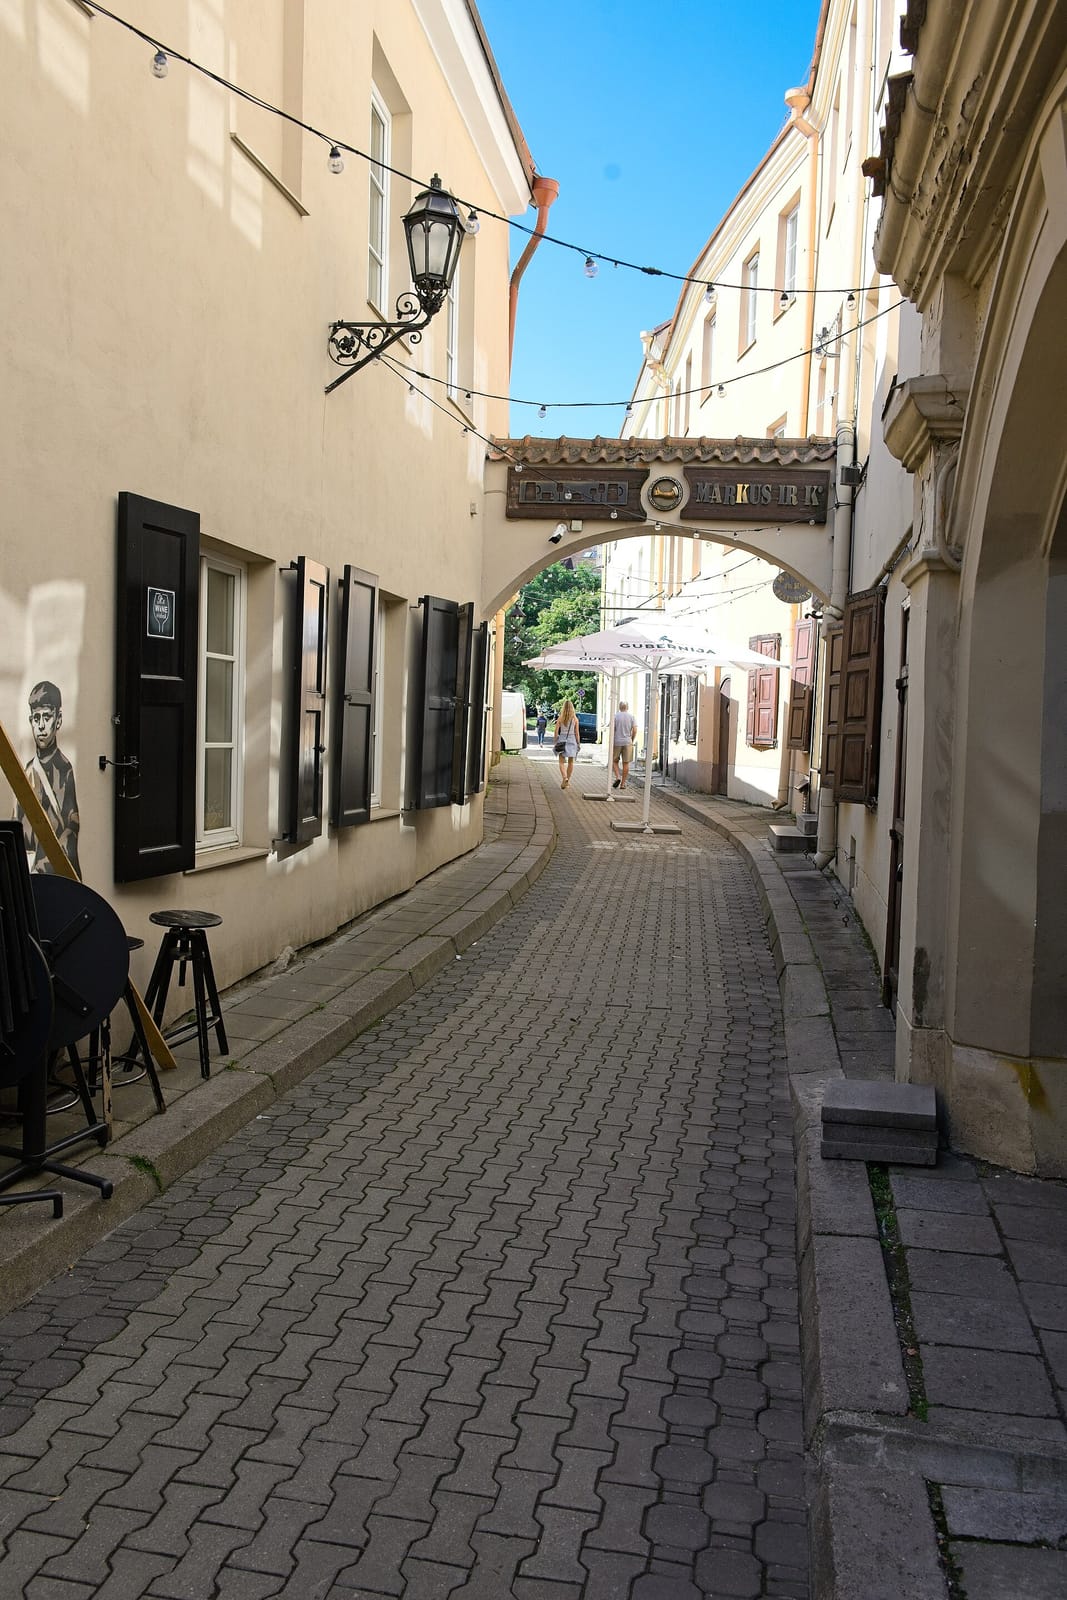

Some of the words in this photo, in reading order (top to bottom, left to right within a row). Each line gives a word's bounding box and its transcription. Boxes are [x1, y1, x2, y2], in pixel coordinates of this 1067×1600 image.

[696, 482, 772, 505] MARKUS
[778, 484, 798, 506] IR
[619, 643, 716, 654] GUBERNIJA
